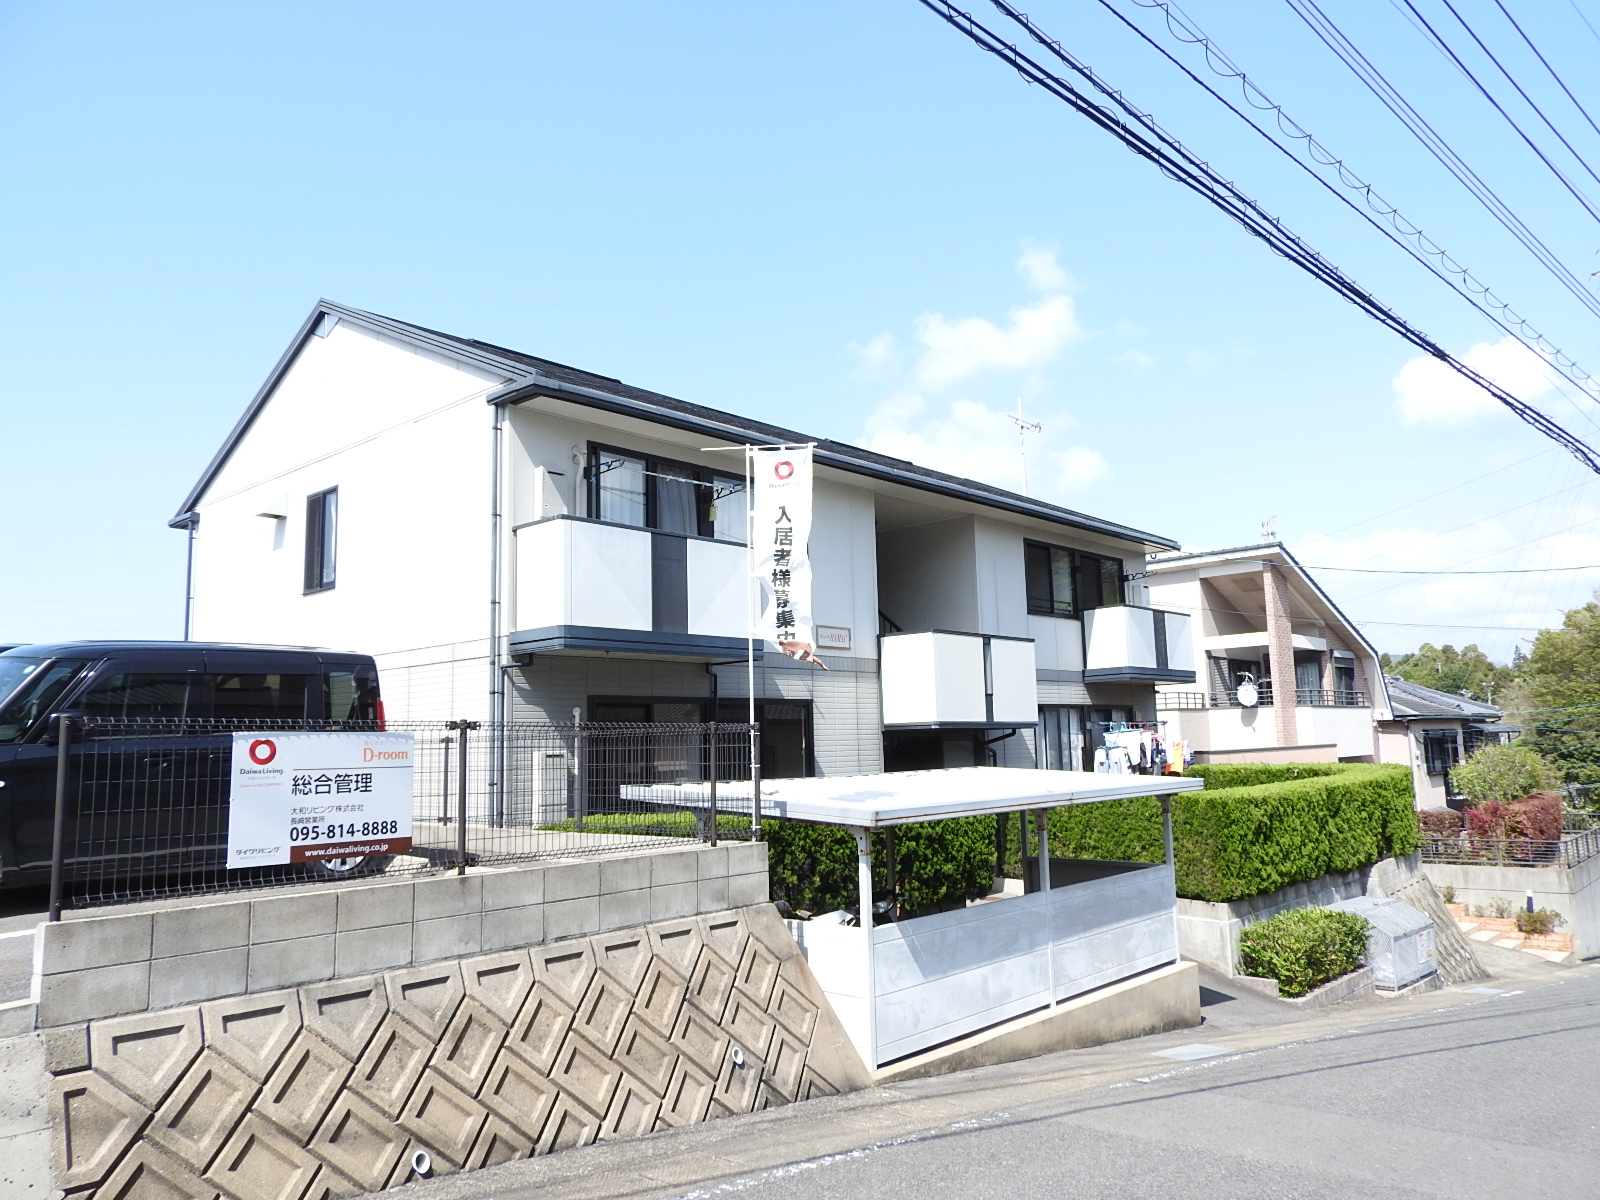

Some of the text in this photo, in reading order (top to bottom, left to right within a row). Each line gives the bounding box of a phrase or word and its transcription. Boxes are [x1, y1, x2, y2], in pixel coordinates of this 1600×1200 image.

[363, 747, 408, 763] D-room
[262, 767, 284, 776] Living
[291, 772, 373, 796] 総合管理
[290, 804, 364, 815] 大和リビング株式会社
[290, 816, 325, 825] 長崎営業所
[289, 820, 398, 842] 095-814-8888
[235, 846, 282, 856] ダイワリビング
[304, 843, 389, 857] www.daiwaliving.co.jp
